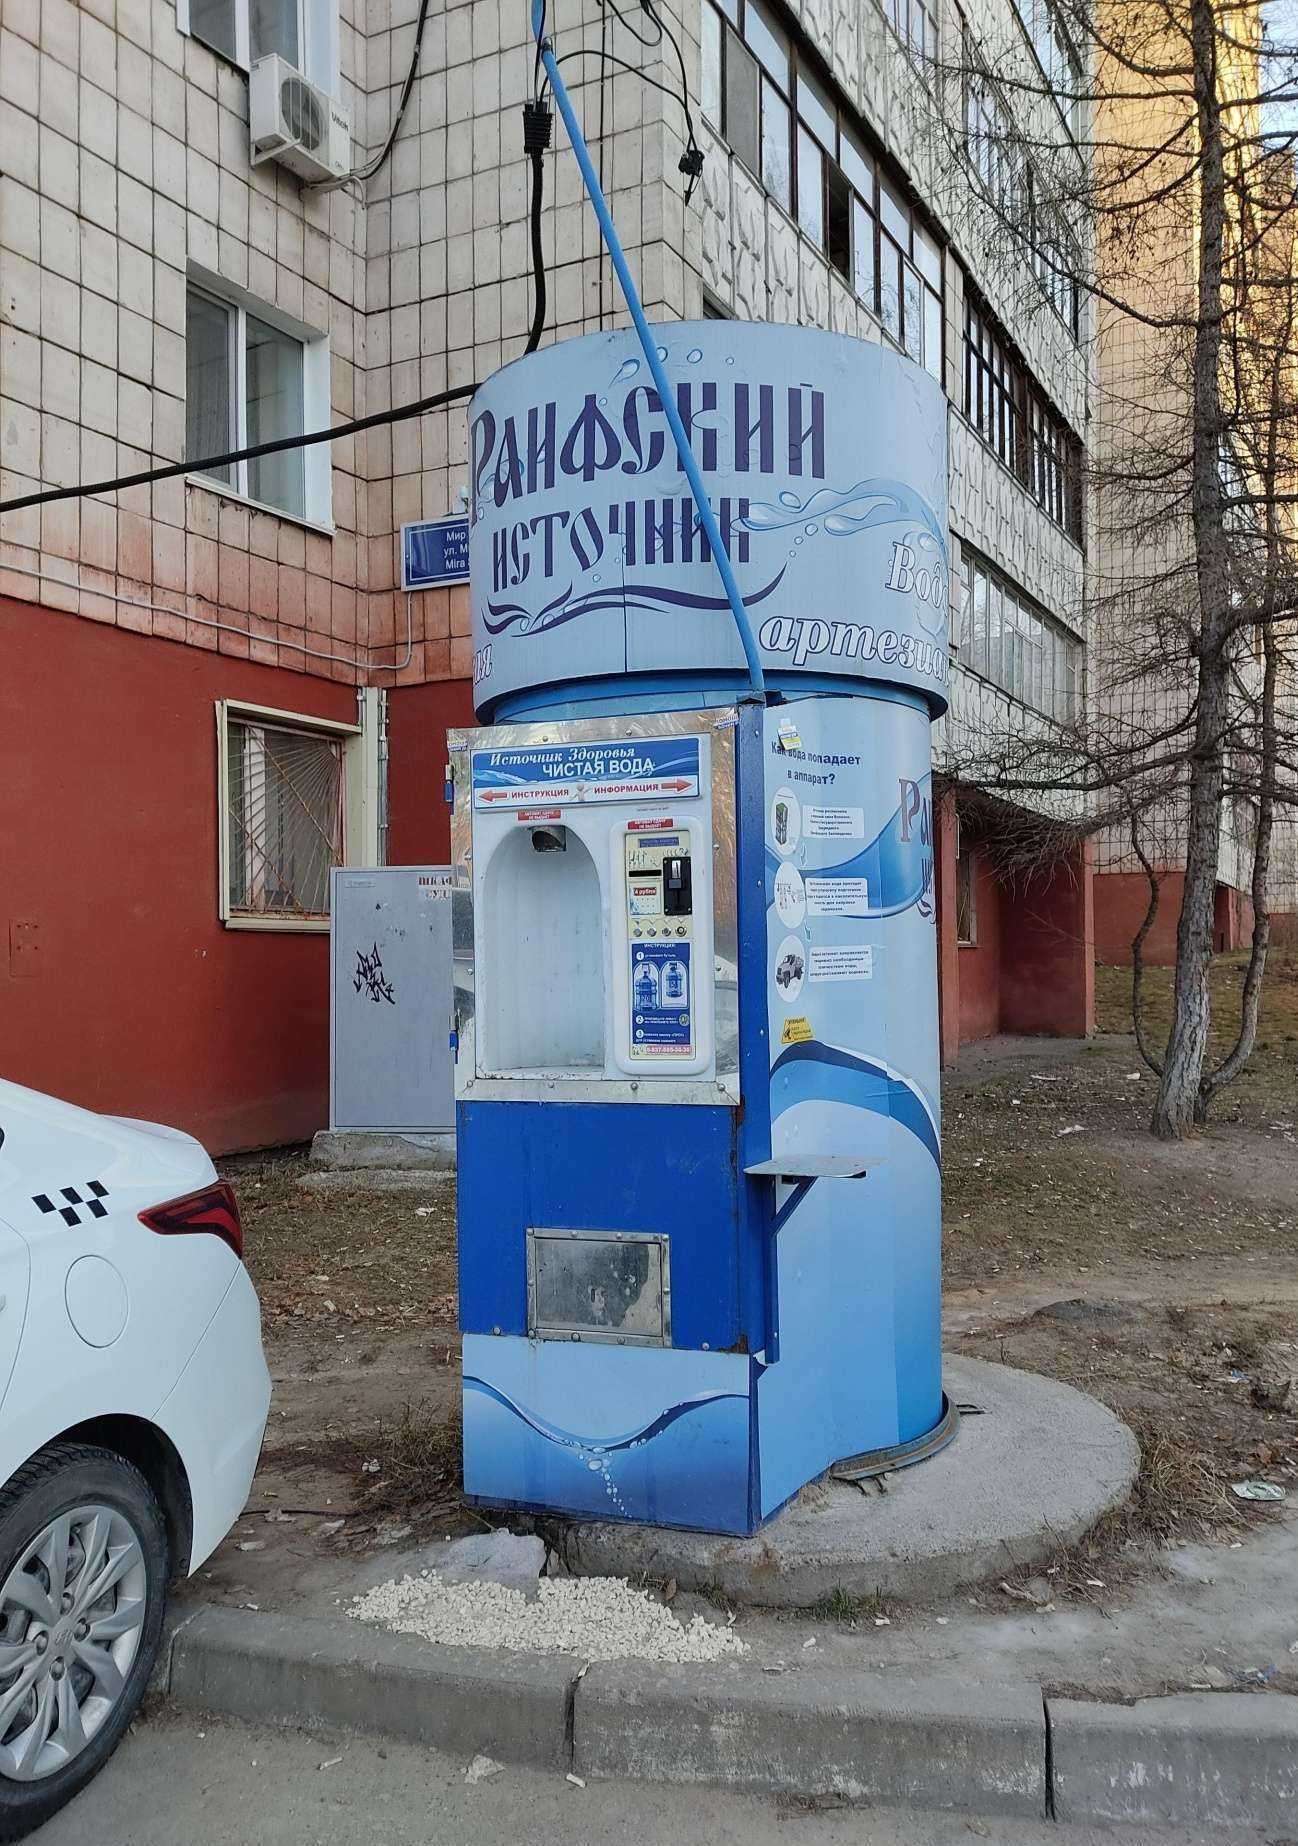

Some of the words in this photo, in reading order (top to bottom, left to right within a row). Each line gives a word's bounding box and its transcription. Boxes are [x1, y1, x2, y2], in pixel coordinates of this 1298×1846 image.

[445, 560, 466, 570] Mira
[490, 752, 563, 767] Источник
[568, 746, 635, 764] Здоровья
[808, 752, 861, 766] попадает
[543, 760, 605, 778] ЧИСТАЯ
[609, 757, 655, 775] ВОДА
[787, 769, 792, 779] в
[794, 770, 836, 786] аппарат?
[511, 788, 569, 799] ИНСТРУКЦИЯ
[594, 783, 659, 795] ИНФОРМАЦИЯ
